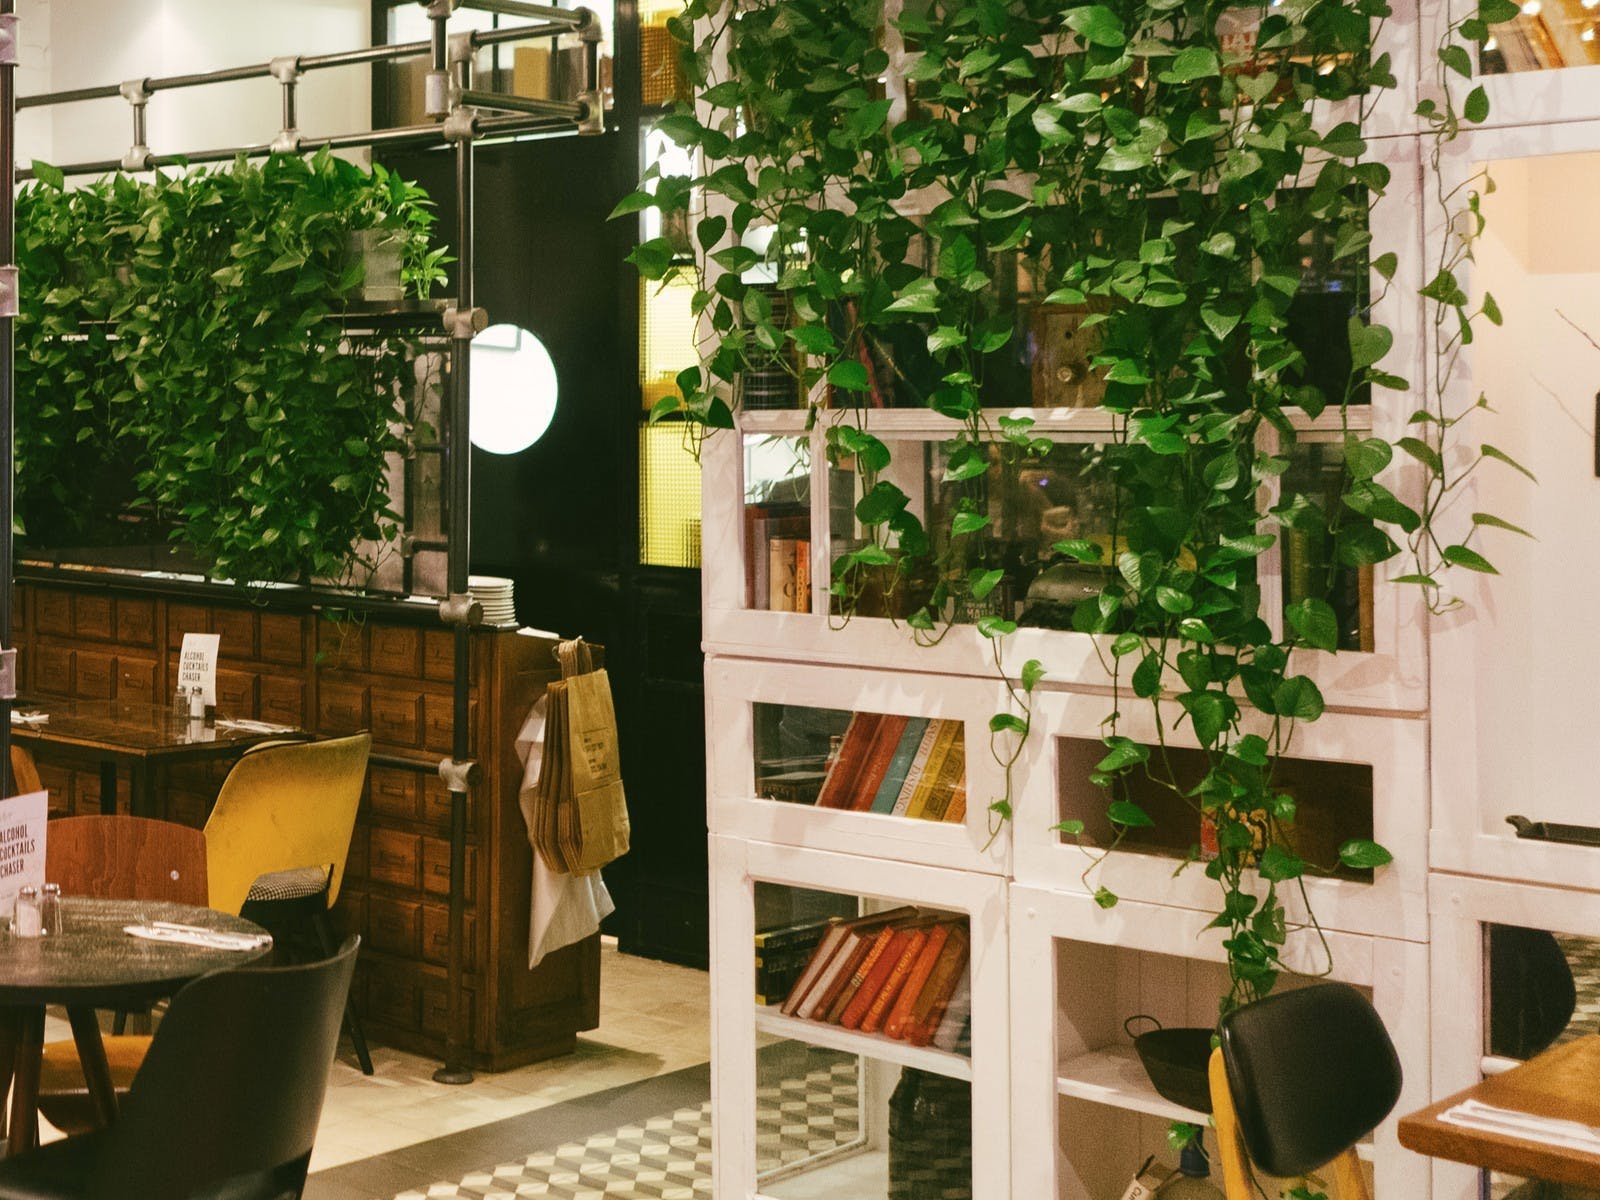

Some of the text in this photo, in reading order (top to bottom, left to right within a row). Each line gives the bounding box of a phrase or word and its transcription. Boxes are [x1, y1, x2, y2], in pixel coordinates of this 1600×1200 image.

[184, 651, 204, 661] ALCOHOL
[183, 662, 208, 671] COCKTAILS
[182, 672, 200, 681] CHASER
[0, 824, 28, 843] ALCOHOL
[0, 839, 35, 861] COCKTAILS
[0, 859, 25, 878] CHASER
